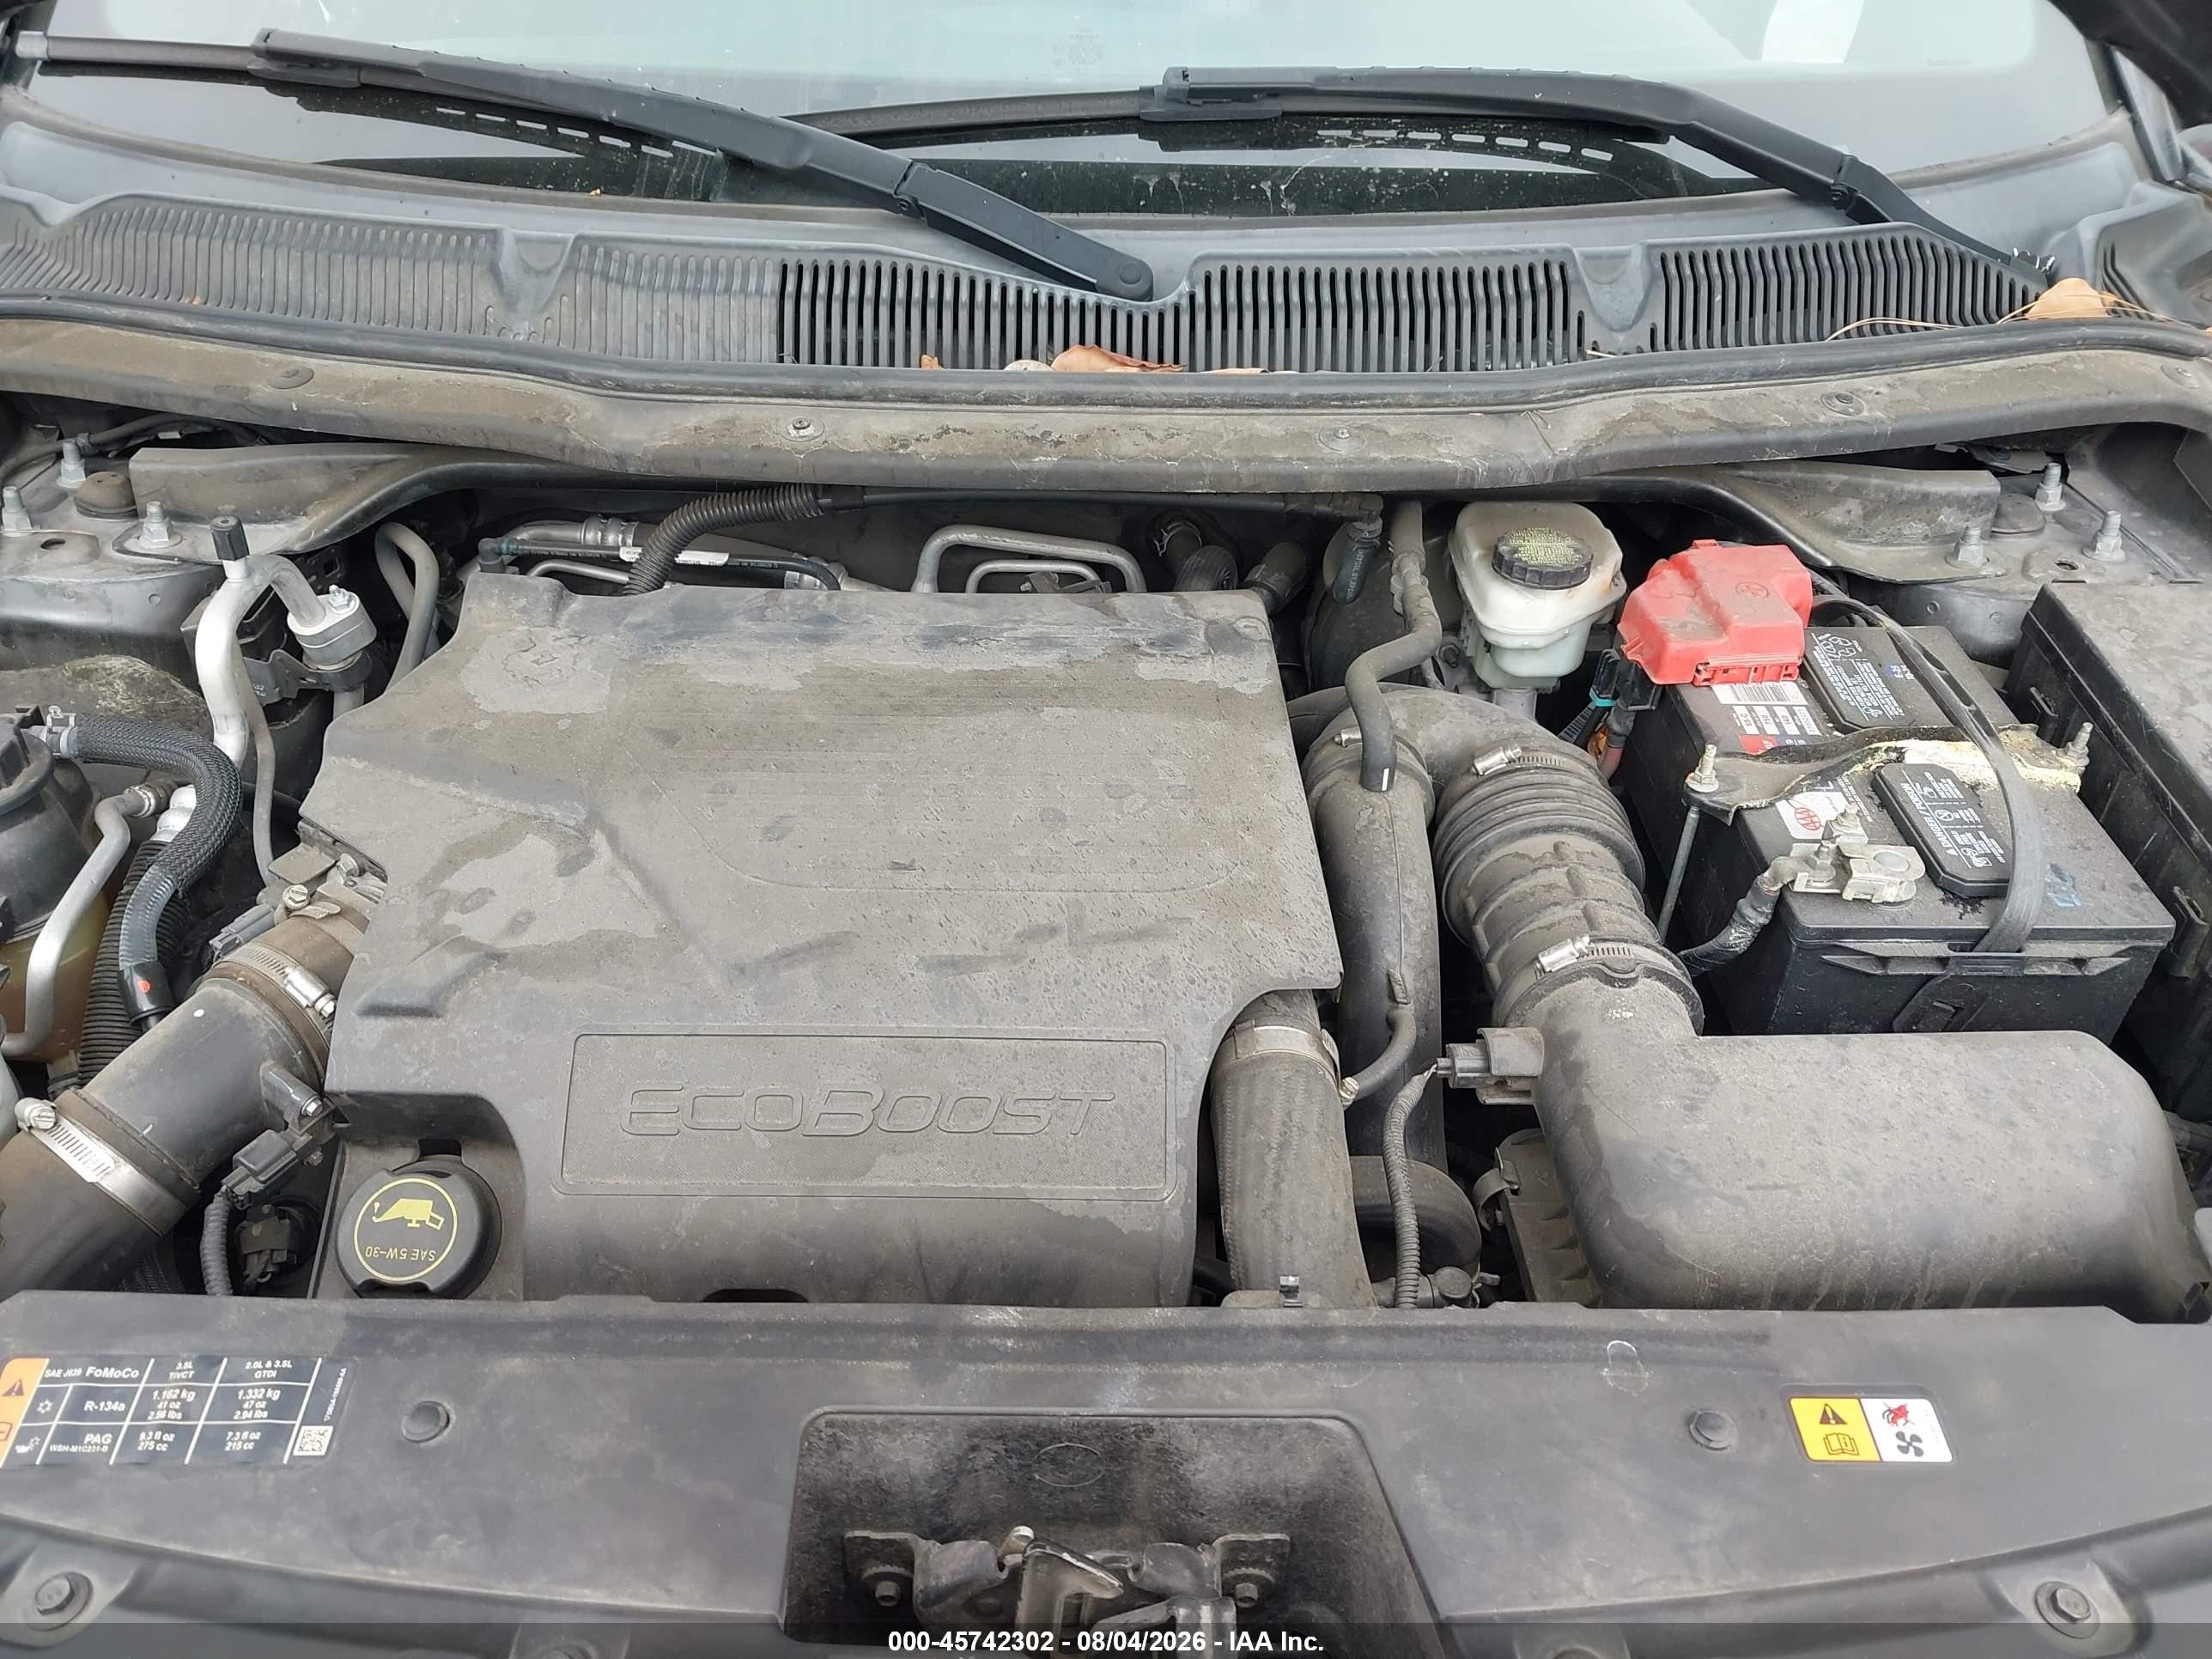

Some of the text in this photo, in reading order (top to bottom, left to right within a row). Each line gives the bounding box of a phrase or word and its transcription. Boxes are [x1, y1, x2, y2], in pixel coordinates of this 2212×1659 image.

[1900, 782, 1926, 810] POISON
[1923, 817, 1953, 848] DANGER
[365, 1246, 436, 1262] SAE 5W-30
[44, 1368, 63, 1377] SAE
[85, 1365, 139, 1378] FoMoCo
[180, 1389, 196, 1401] kg
[238, 1388, 282, 1401] 1.332 kg
[84, 1401, 125, 1412] R-134a
[167, 1410, 183, 1419] lbs
[234, 1410, 268, 1419] 2.94 lbs
[84, 1433, 112, 1444] PAG
[162, 1433, 175, 1442] oz
[226, 1431, 240, 1441] 7.3
[249, 1431, 261, 1440] oz
[137, 1441, 155, 1450] 275
[224, 1441, 242, 1451] 215
